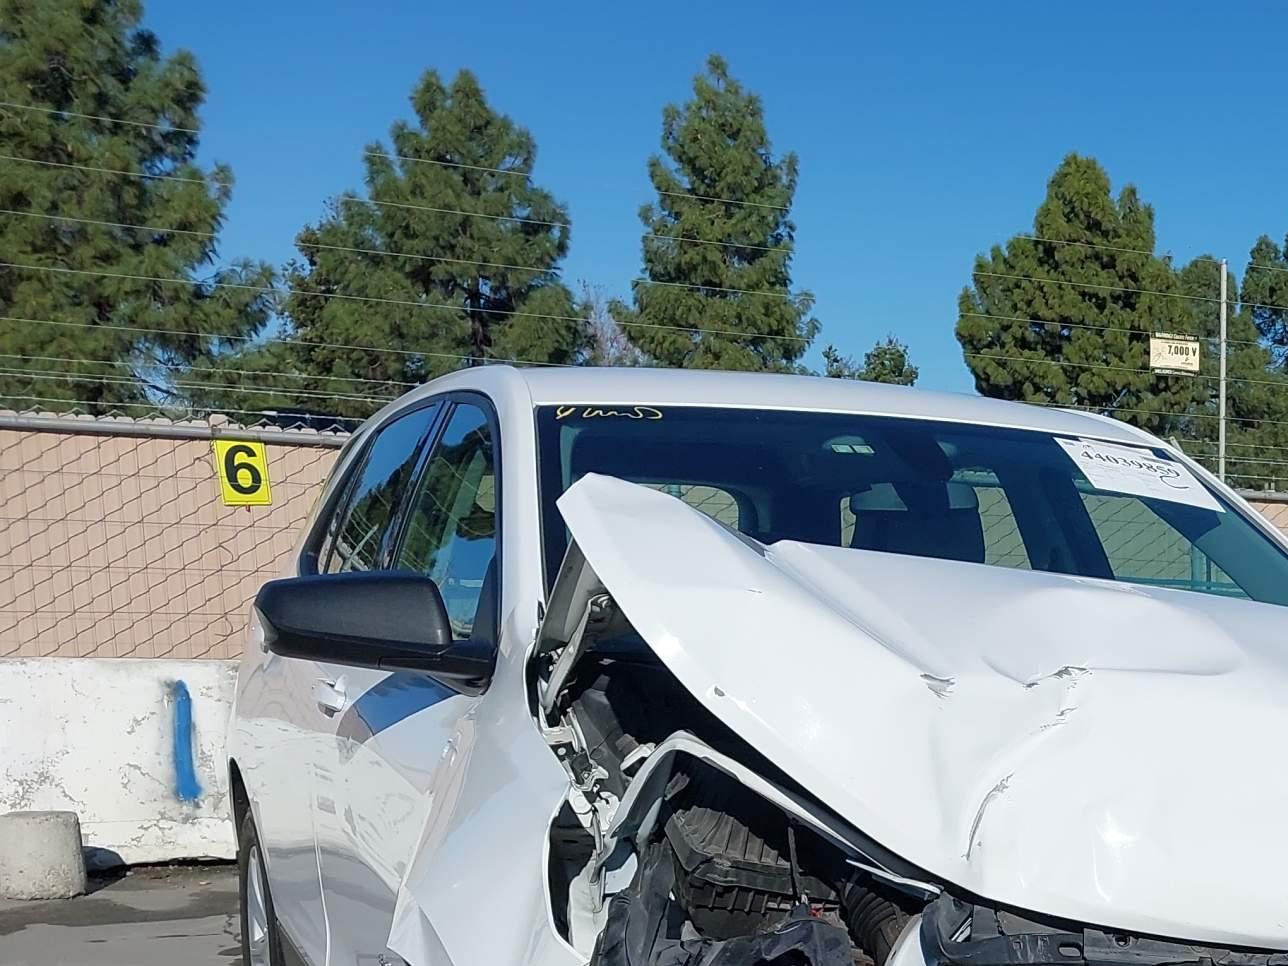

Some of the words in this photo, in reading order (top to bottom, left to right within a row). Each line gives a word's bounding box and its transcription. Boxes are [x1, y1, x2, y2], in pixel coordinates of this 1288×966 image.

[1167, 344, 1190, 357] 7,000
[1192, 347, 1198, 357] V
[224, 444, 263, 495] 6
[1081, 451, 1185, 485] 44039859
